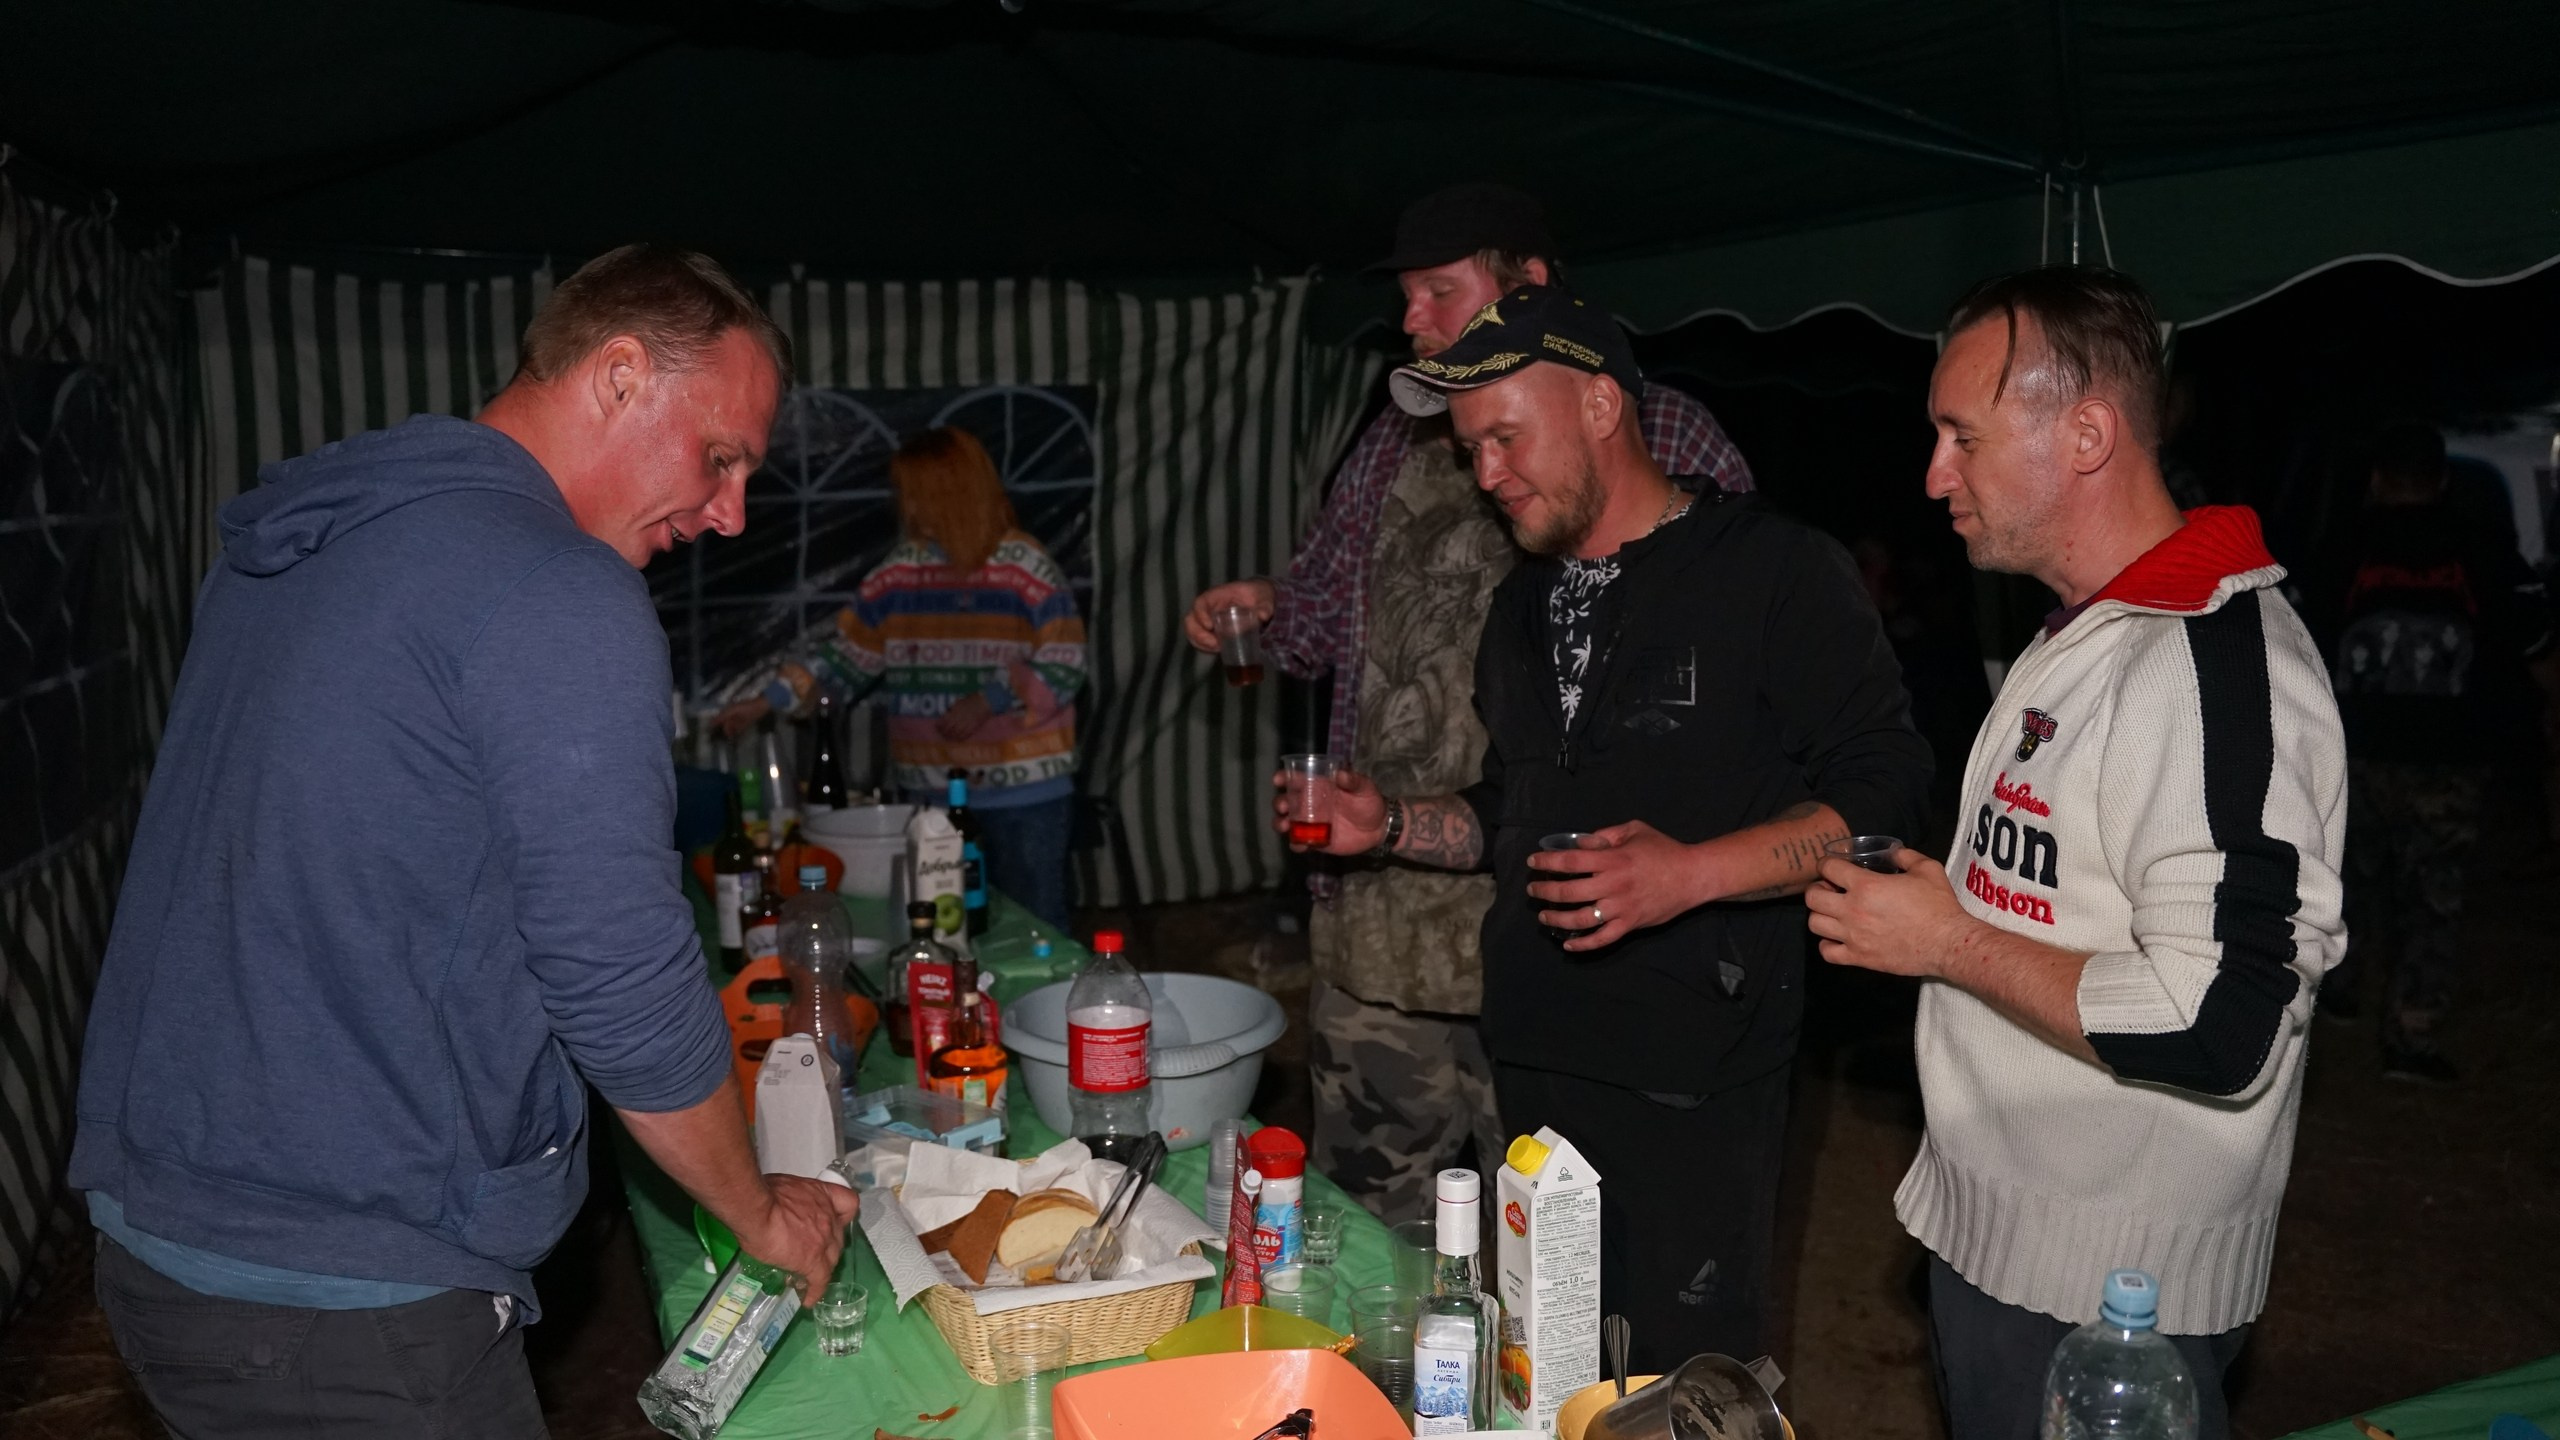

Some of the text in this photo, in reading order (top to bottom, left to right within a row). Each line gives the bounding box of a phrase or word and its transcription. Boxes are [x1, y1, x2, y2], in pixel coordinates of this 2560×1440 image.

[1542, 341, 1568, 355] СИЛЫ
[1967, 803, 2058, 890] son
[1253, 1234, 1281, 1247] ОЛЬ
[1435, 1359, 1461, 1369] ТАЛКА
[1433, 1374, 1462, 1385] Сибири
